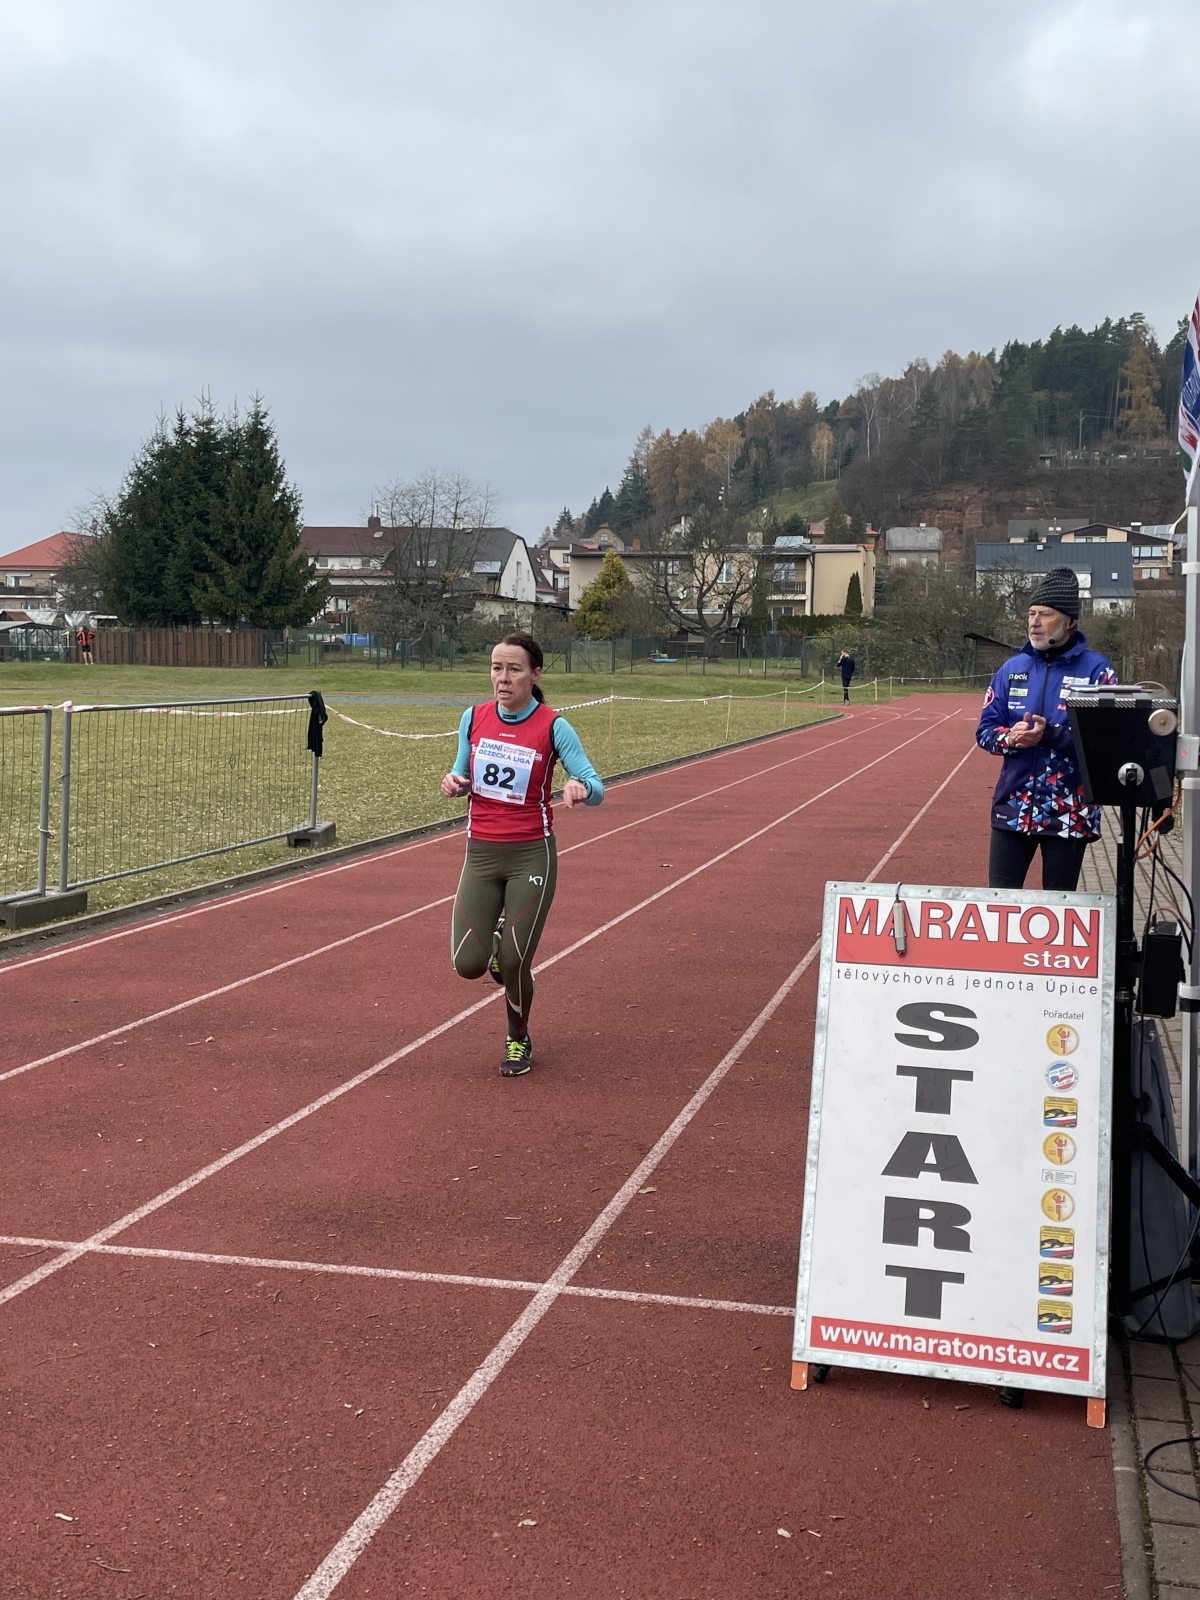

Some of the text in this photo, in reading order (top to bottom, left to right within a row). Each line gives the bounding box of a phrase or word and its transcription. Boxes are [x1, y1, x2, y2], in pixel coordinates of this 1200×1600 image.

[513, 757, 531, 766] LIGA
[483, 763, 516, 790] 82
[839, 896, 1100, 948] MARATON
[1022, 950, 1091, 970] stav
[837, 968, 1098, 996] tělovýchovná jednota Úpice
[1043, 1009, 1084, 1020] Pořadatel
[881, 1001, 980, 1320] START
[819, 1324, 1080, 1373] www.maratonstav.cz
